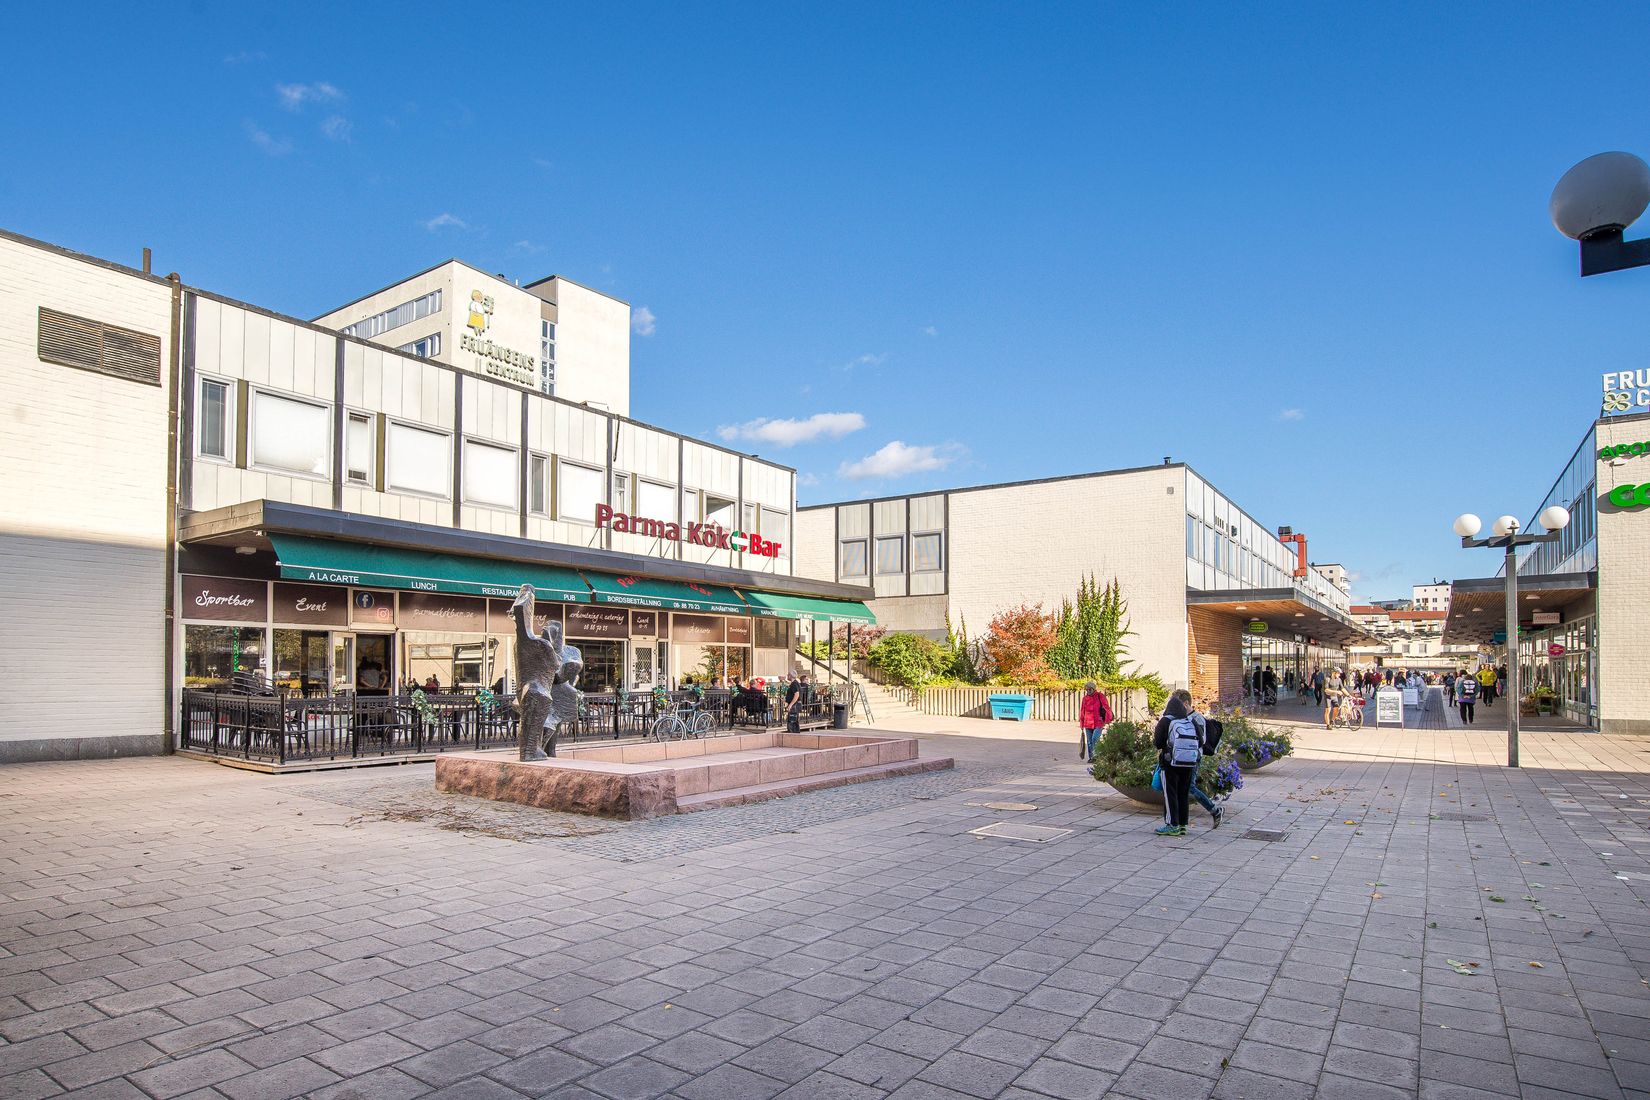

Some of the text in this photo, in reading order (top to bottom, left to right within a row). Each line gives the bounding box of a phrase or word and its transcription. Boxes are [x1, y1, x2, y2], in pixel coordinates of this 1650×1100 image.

[459, 332, 535, 372] FRUÄNGENS
[486, 360, 535, 387] CENTRUM
[595, 503, 782, 558] Parma Kök Bar
[309, 572, 359, 583] A LA CARTE
[411, 581, 437, 590] LUNCH
[482, 587, 521, 597] RESTAURAN
[195, 590, 254, 607] Sportbar
[295, 597, 327, 612] Event
[563, 593, 576, 601] PUB
